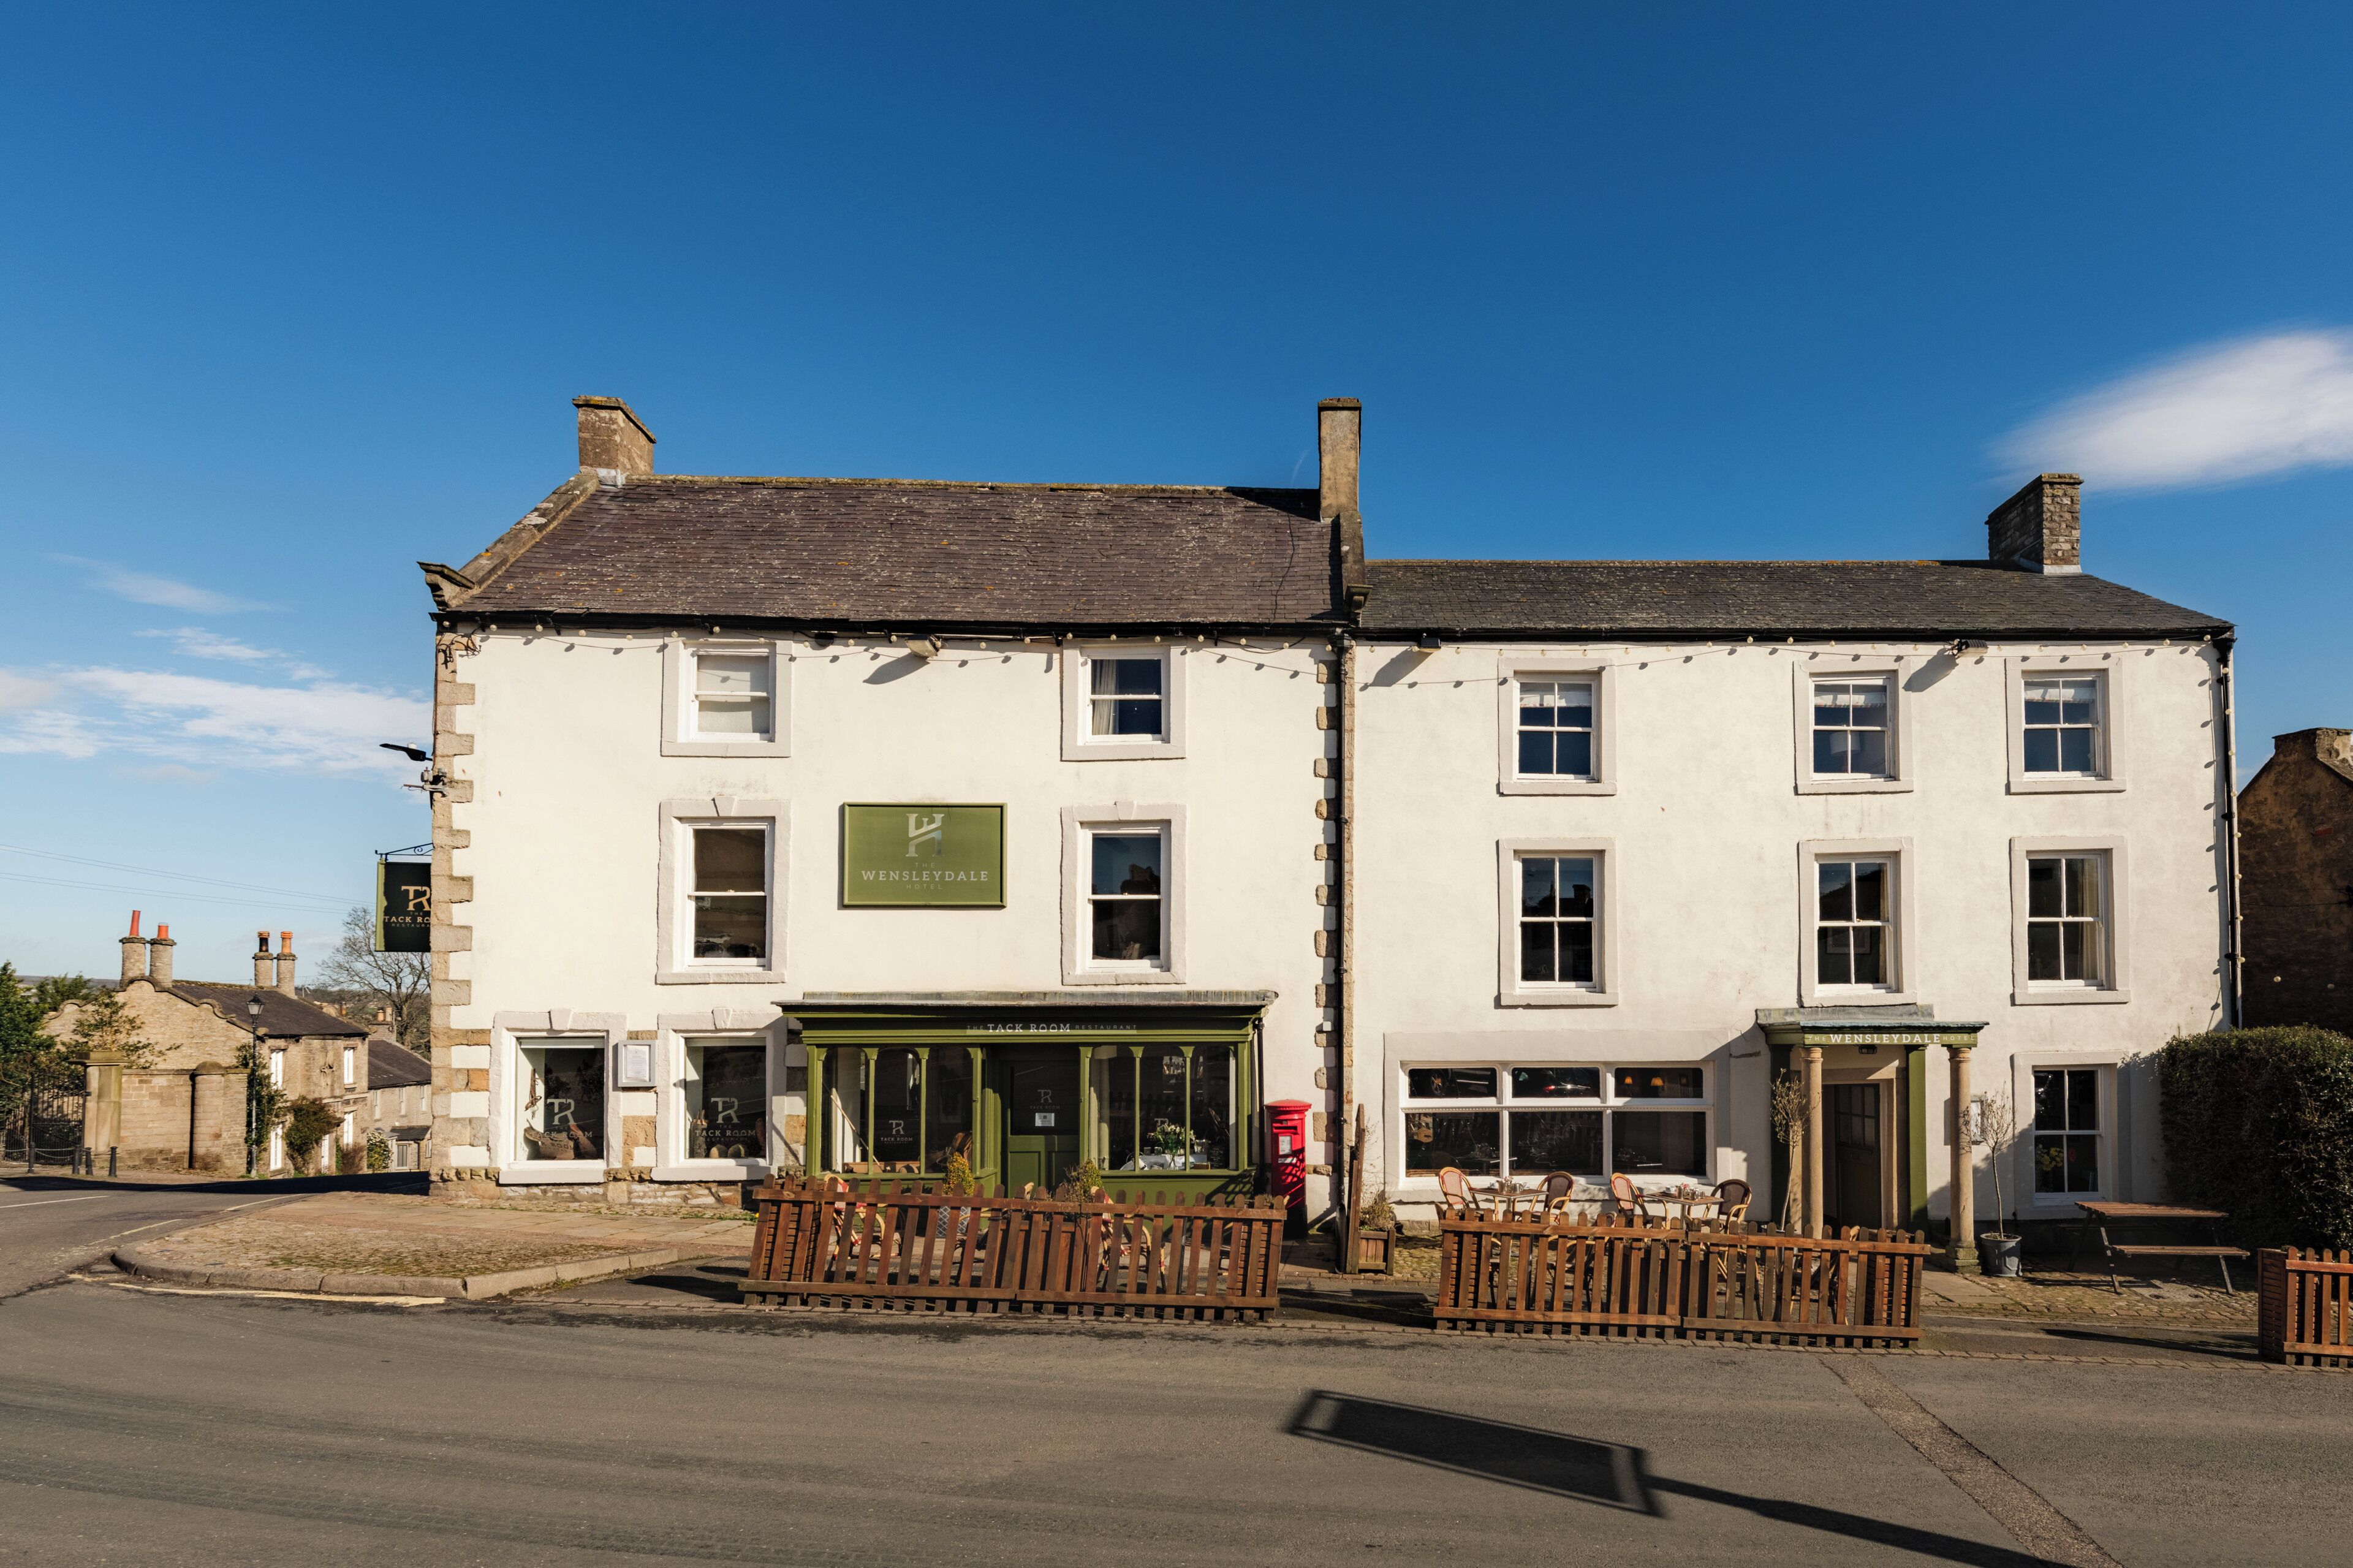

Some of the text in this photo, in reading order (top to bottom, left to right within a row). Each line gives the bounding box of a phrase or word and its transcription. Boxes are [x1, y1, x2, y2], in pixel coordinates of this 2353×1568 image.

[861, 870, 988, 882] WENSLEYDALE
[987, 1024, 1023, 1032] TACK
[1029, 1024, 1070, 1032] ROOM
[1829, 1034, 1941, 1043] WENSLEYDALE
[711, 1097, 740, 1123] TR
